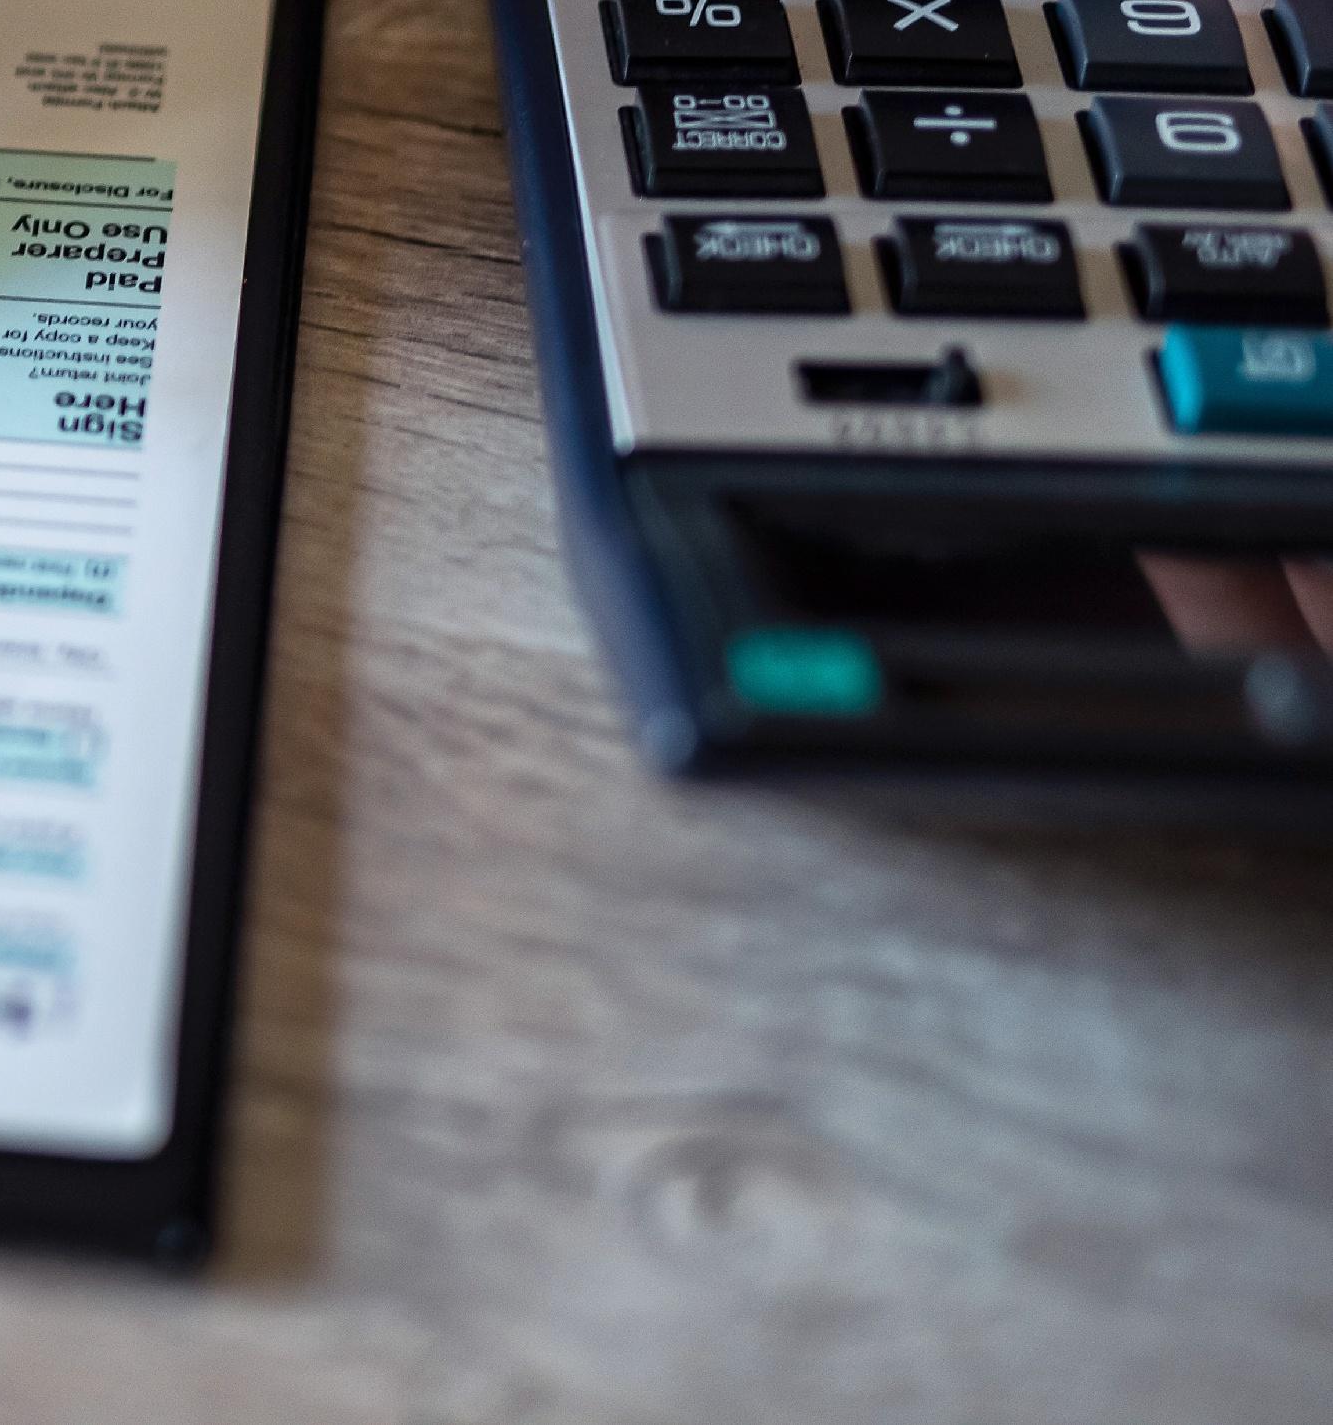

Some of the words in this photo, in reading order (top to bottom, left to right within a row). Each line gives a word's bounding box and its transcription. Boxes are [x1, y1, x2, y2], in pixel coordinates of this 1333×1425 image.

[672, 130, 787, 151] CORRECT
[1155, 110, 1241, 153] 9
[6, 176, 131, 199] Disclosure,
[134, 186, 175, 202] For
[10, 213, 92, 241] Only
[101, 222, 169, 246] Use
[10, 241, 166, 270] Preparer
[84, 270, 163, 295] Paid
[31, 312, 111, 328] records.
[113, 316, 159, 332] your
[1, 329, 29, 344] for
[33, 327, 83, 344] copy
[104, 333, 156, 352] Keep
[114, 354, 154, 370] See
[27, 365, 100, 382] return?
[102, 370, 152, 388] Joint
[53, 390, 147, 419] Here
[56, 412, 144, 442] Sign
